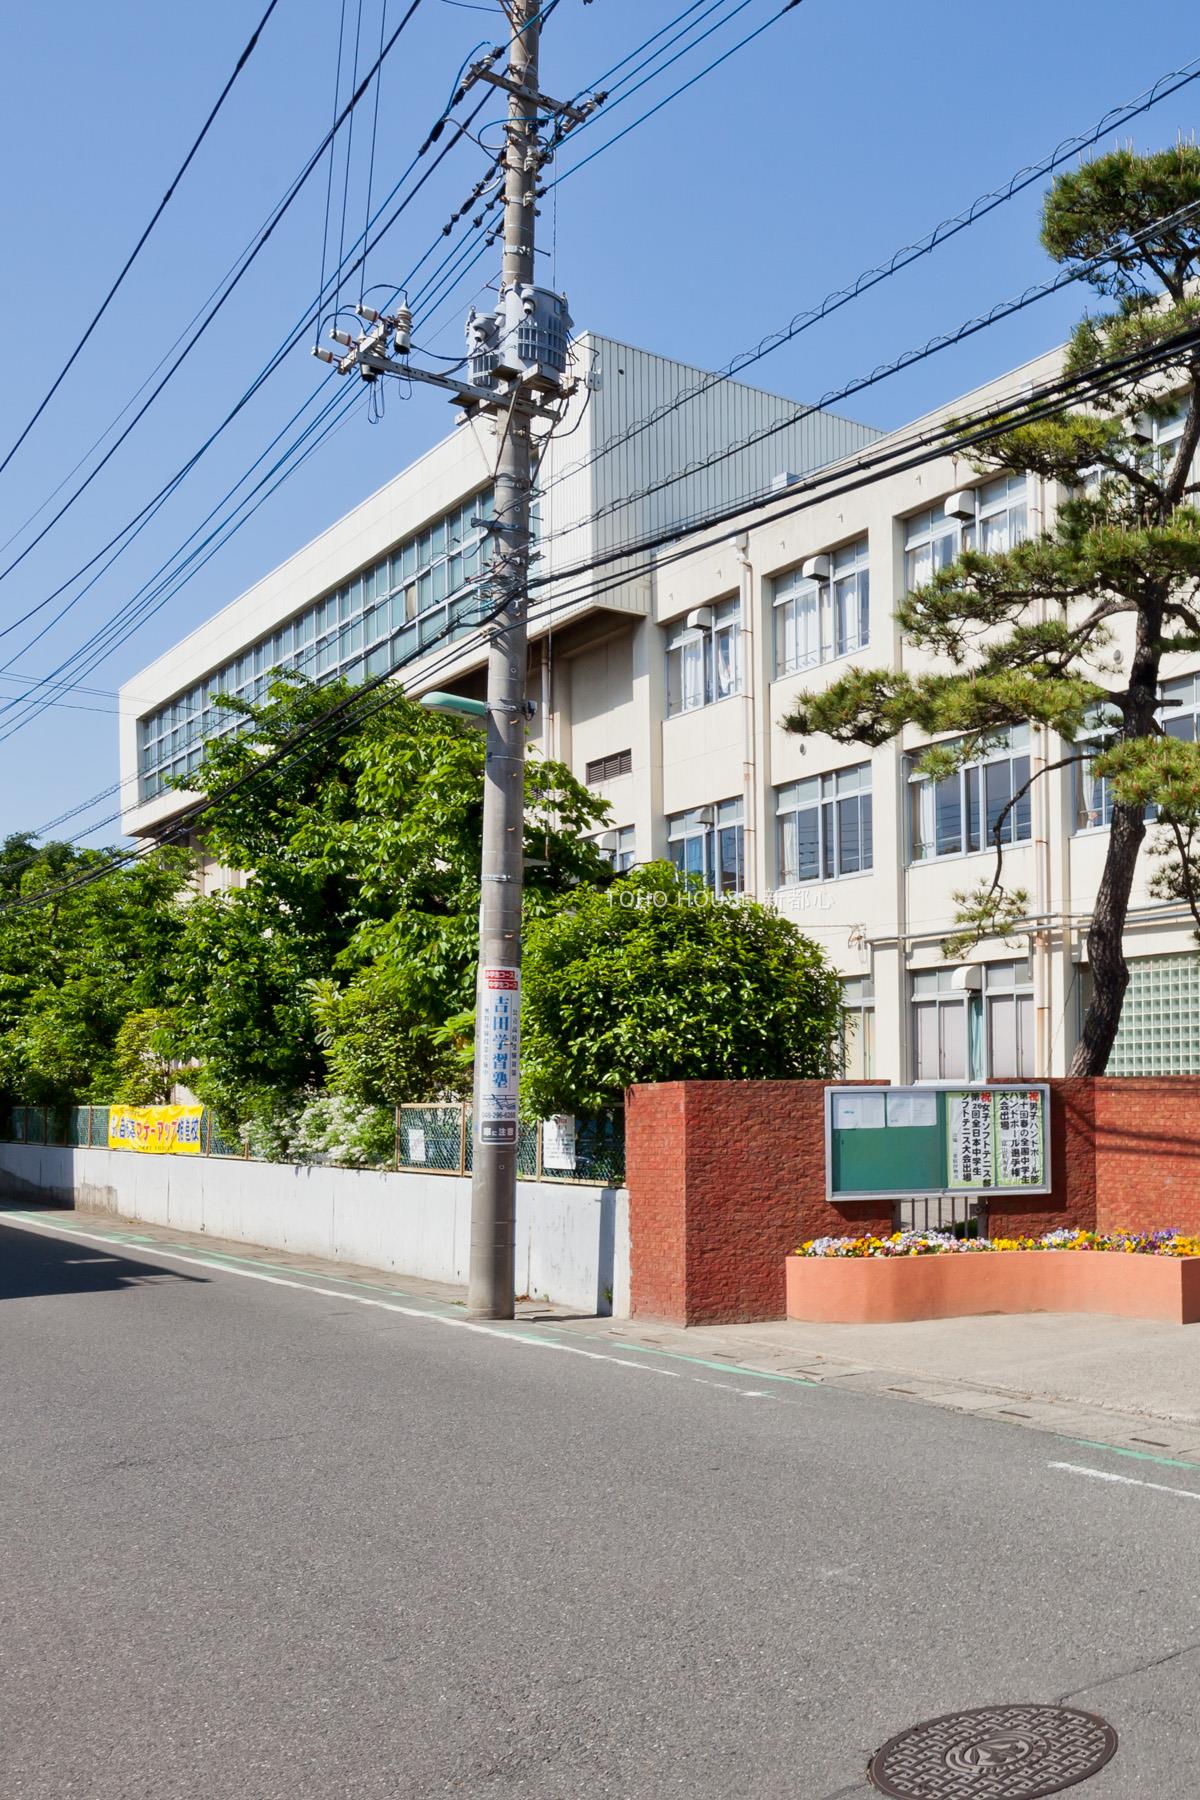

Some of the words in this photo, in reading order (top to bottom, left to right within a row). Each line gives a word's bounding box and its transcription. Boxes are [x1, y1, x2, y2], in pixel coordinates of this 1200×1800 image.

[492, 996, 509, 1089] 吉田学習塾
